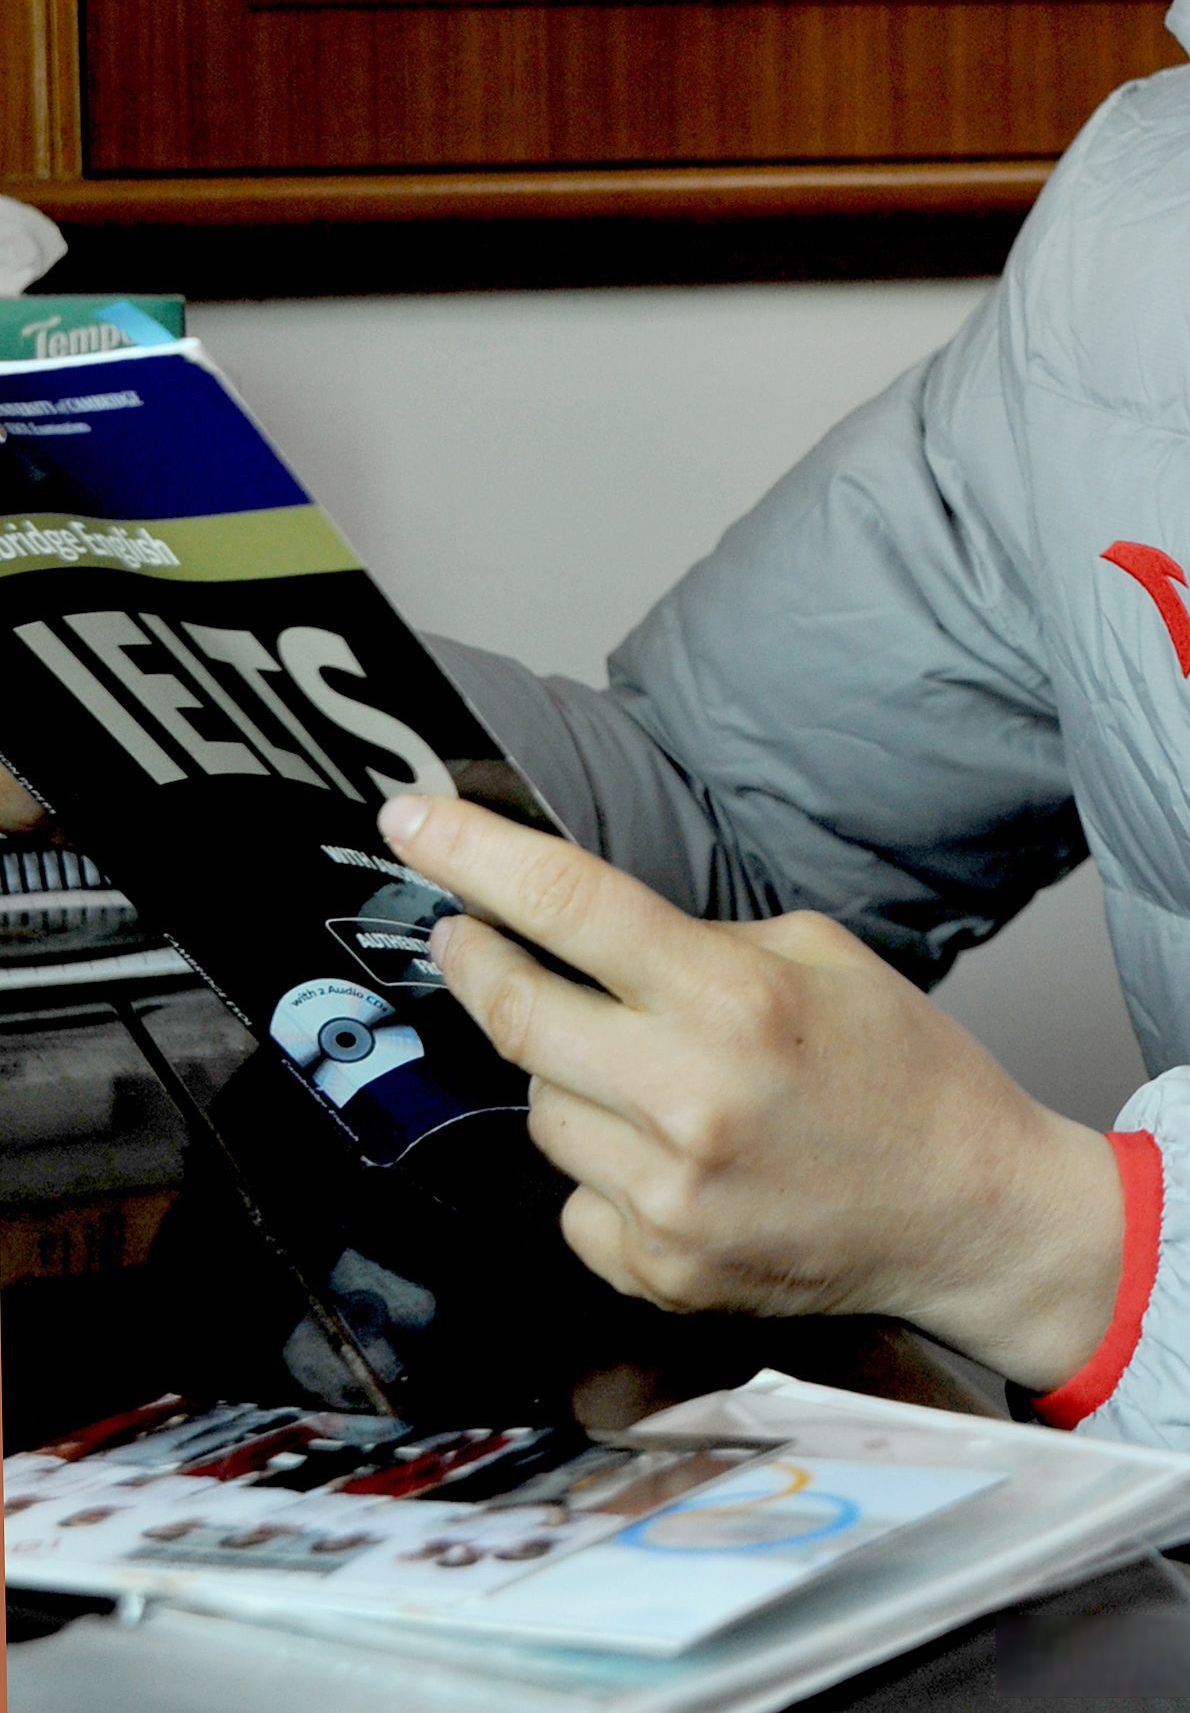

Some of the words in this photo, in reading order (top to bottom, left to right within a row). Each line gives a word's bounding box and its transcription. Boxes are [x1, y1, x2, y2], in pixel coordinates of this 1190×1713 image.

[69, 521, 181, 570] English
[12, 611, 459, 805] IELTS
[321, 844, 377, 870] WITH
[291, 989, 318, 1007] with
[317, 988, 326, 996] 2
[328, 985, 364, 1000] Audio
[365, 995, 389, 1013] CDs
